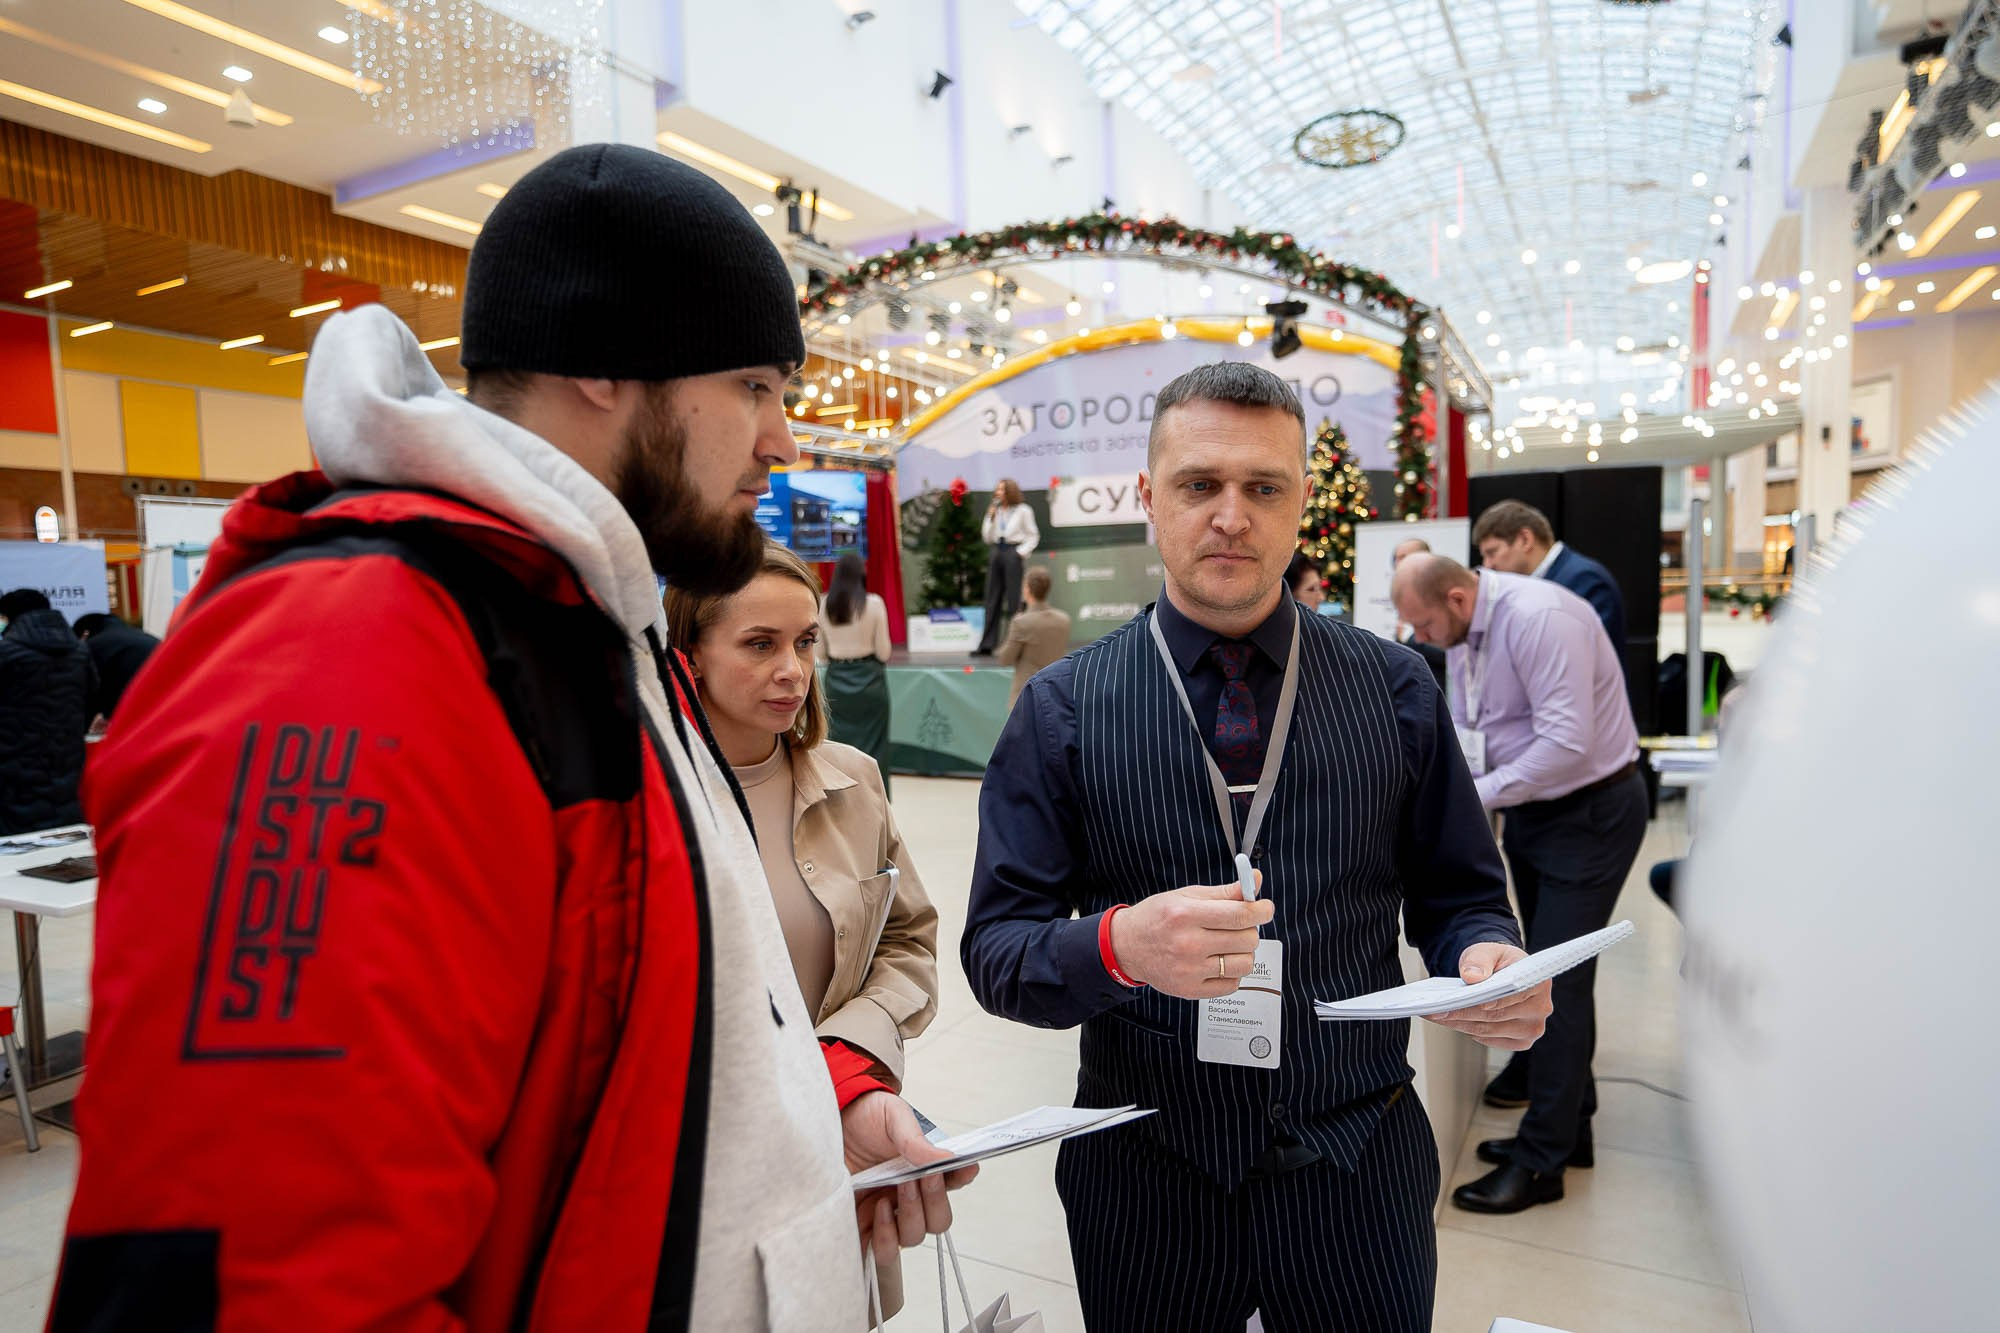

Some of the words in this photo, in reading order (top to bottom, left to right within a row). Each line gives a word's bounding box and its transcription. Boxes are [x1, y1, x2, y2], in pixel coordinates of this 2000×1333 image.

[267, 723, 361, 790] DU
[252, 795, 387, 868] ST2
[239, 868, 328, 939] DU
[220, 945, 317, 1020] ST
[1208, 997, 1246, 1006] Дорофеев
[1208, 1006, 1239, 1014] Василий
[1207, 1014, 1263, 1026] Станиславович
